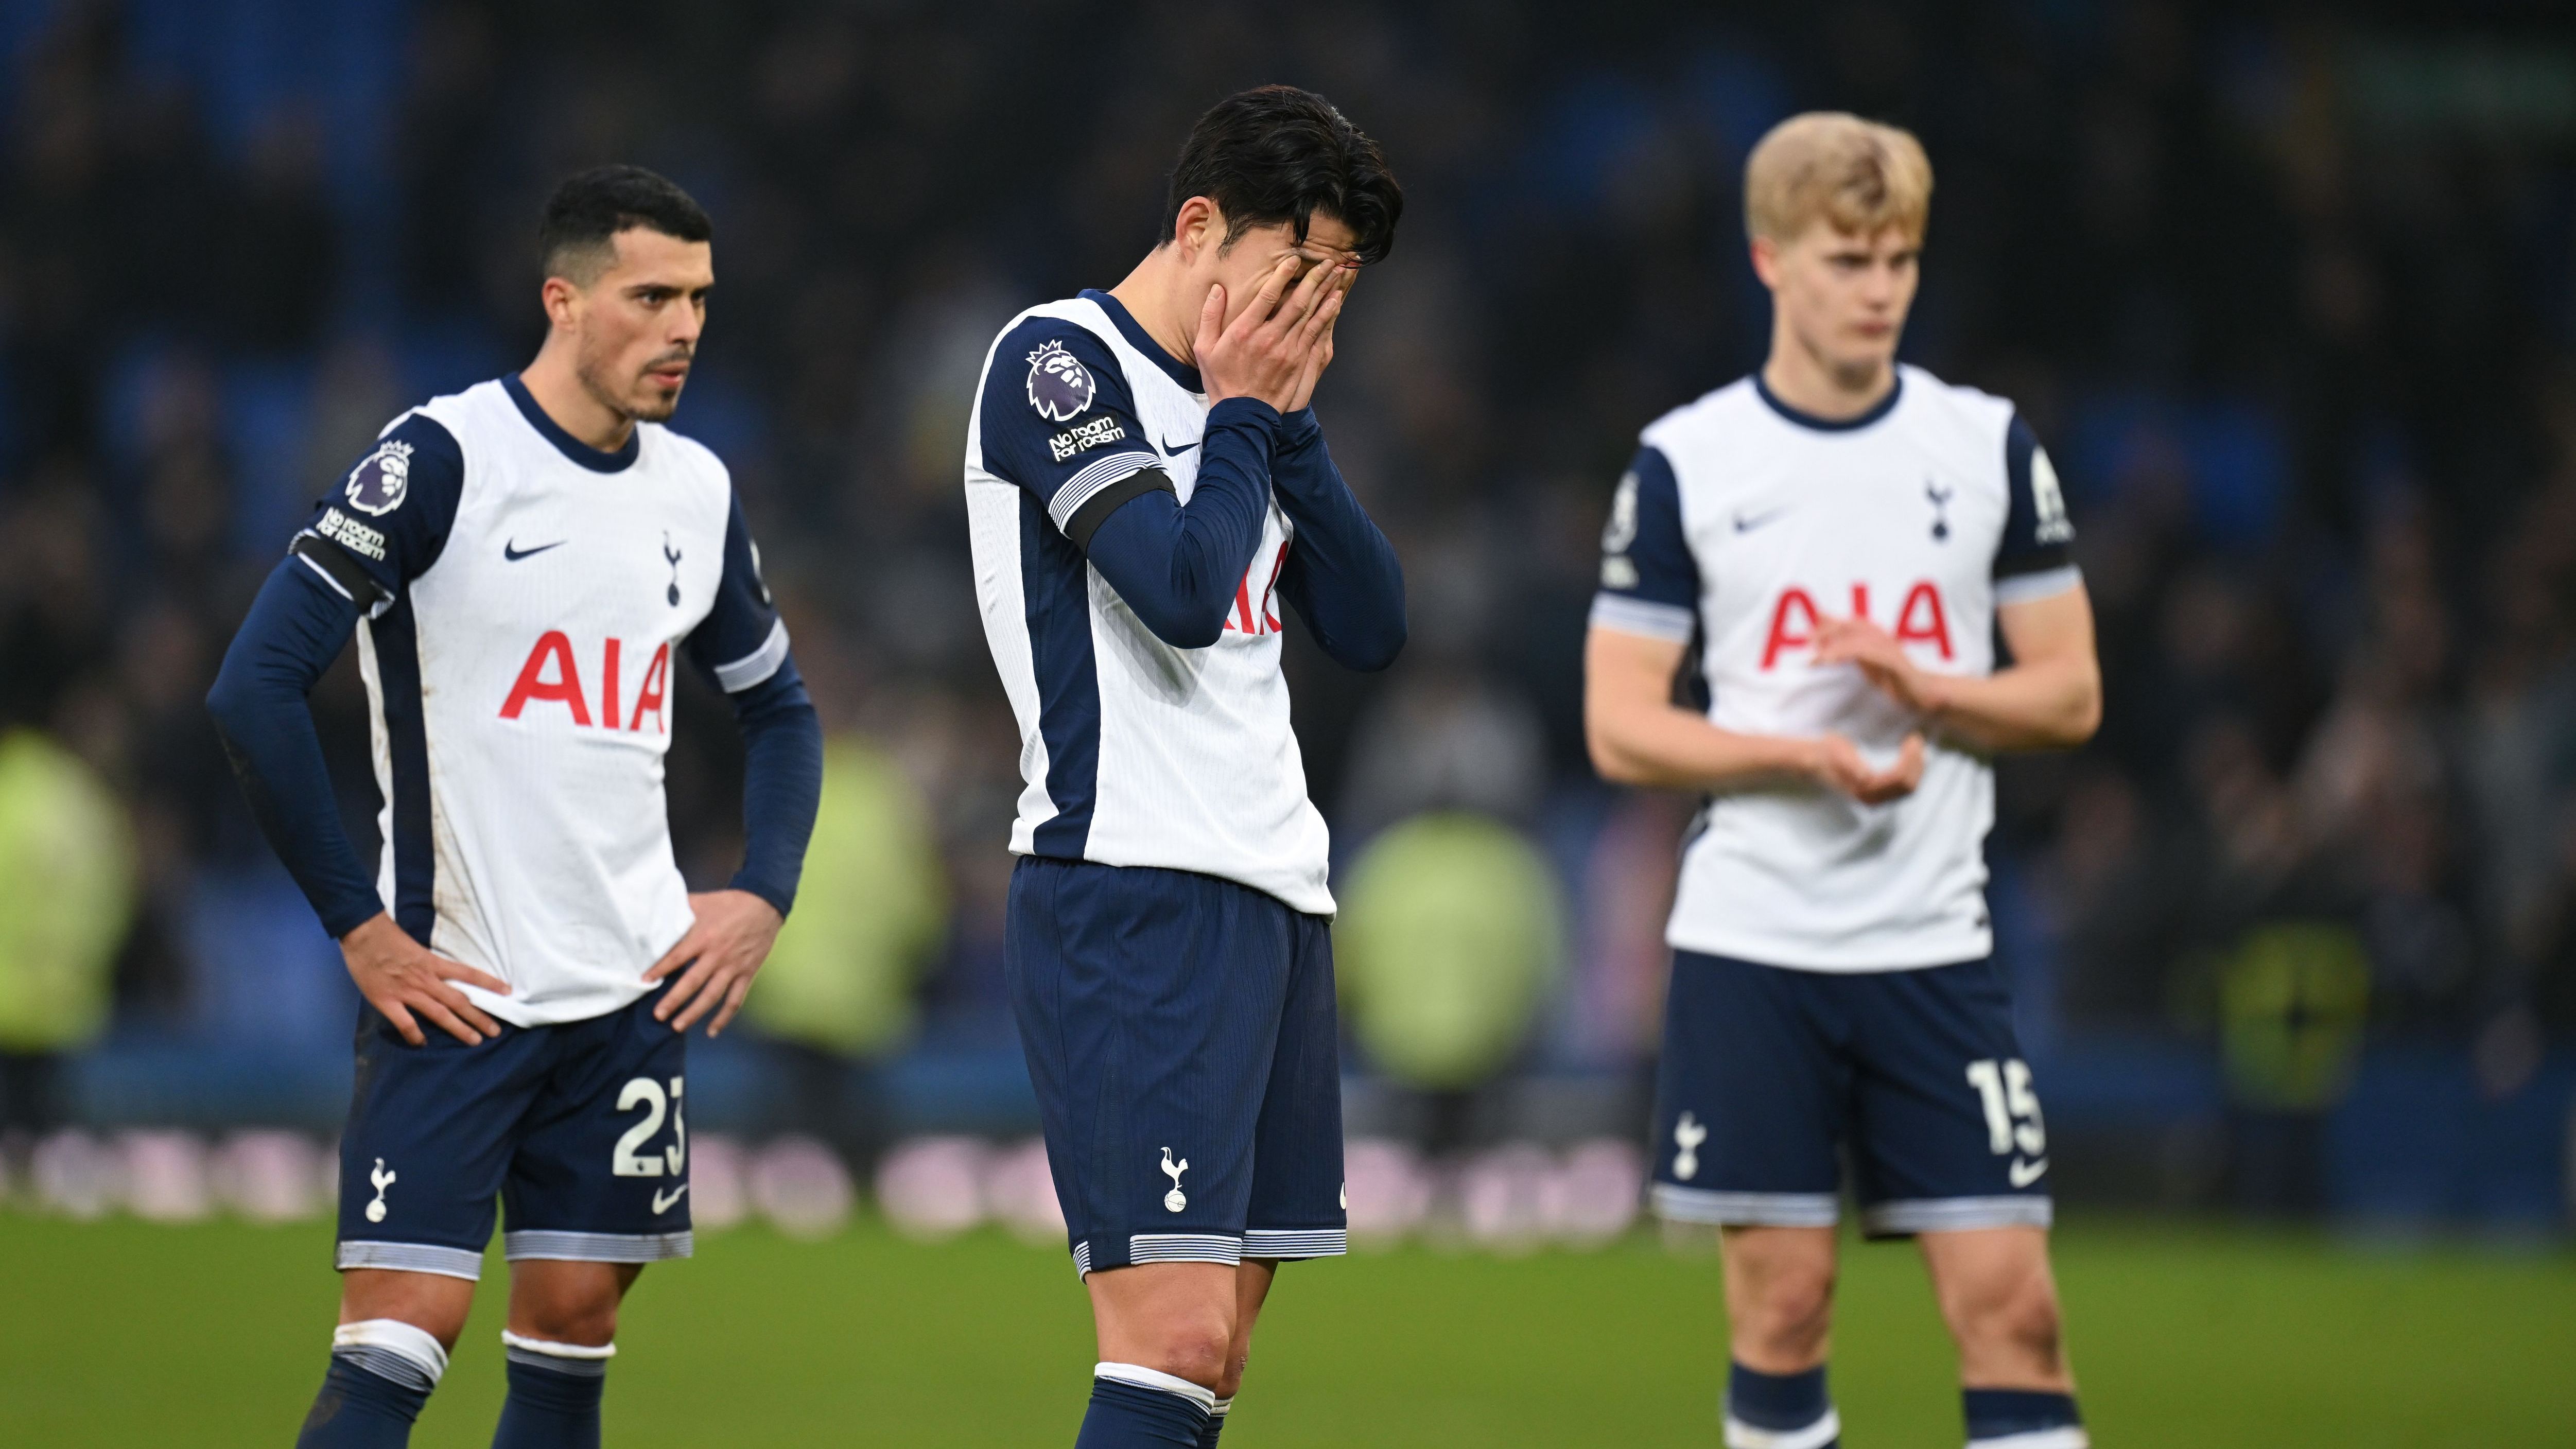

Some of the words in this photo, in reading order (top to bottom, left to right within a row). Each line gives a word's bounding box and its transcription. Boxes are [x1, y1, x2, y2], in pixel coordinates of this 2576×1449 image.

[1049, 433, 1072, 451] No
[1070, 416, 1114, 440] room
[1053, 443, 1076, 462] for
[1077, 427, 1125, 451] racism
[323, 507, 344, 527] No
[342, 517, 385, 548] room
[498, 630, 669, 735] AIA
[613, 1076, 685, 1177] 23
[1964, 1058, 2046, 1156] 15
